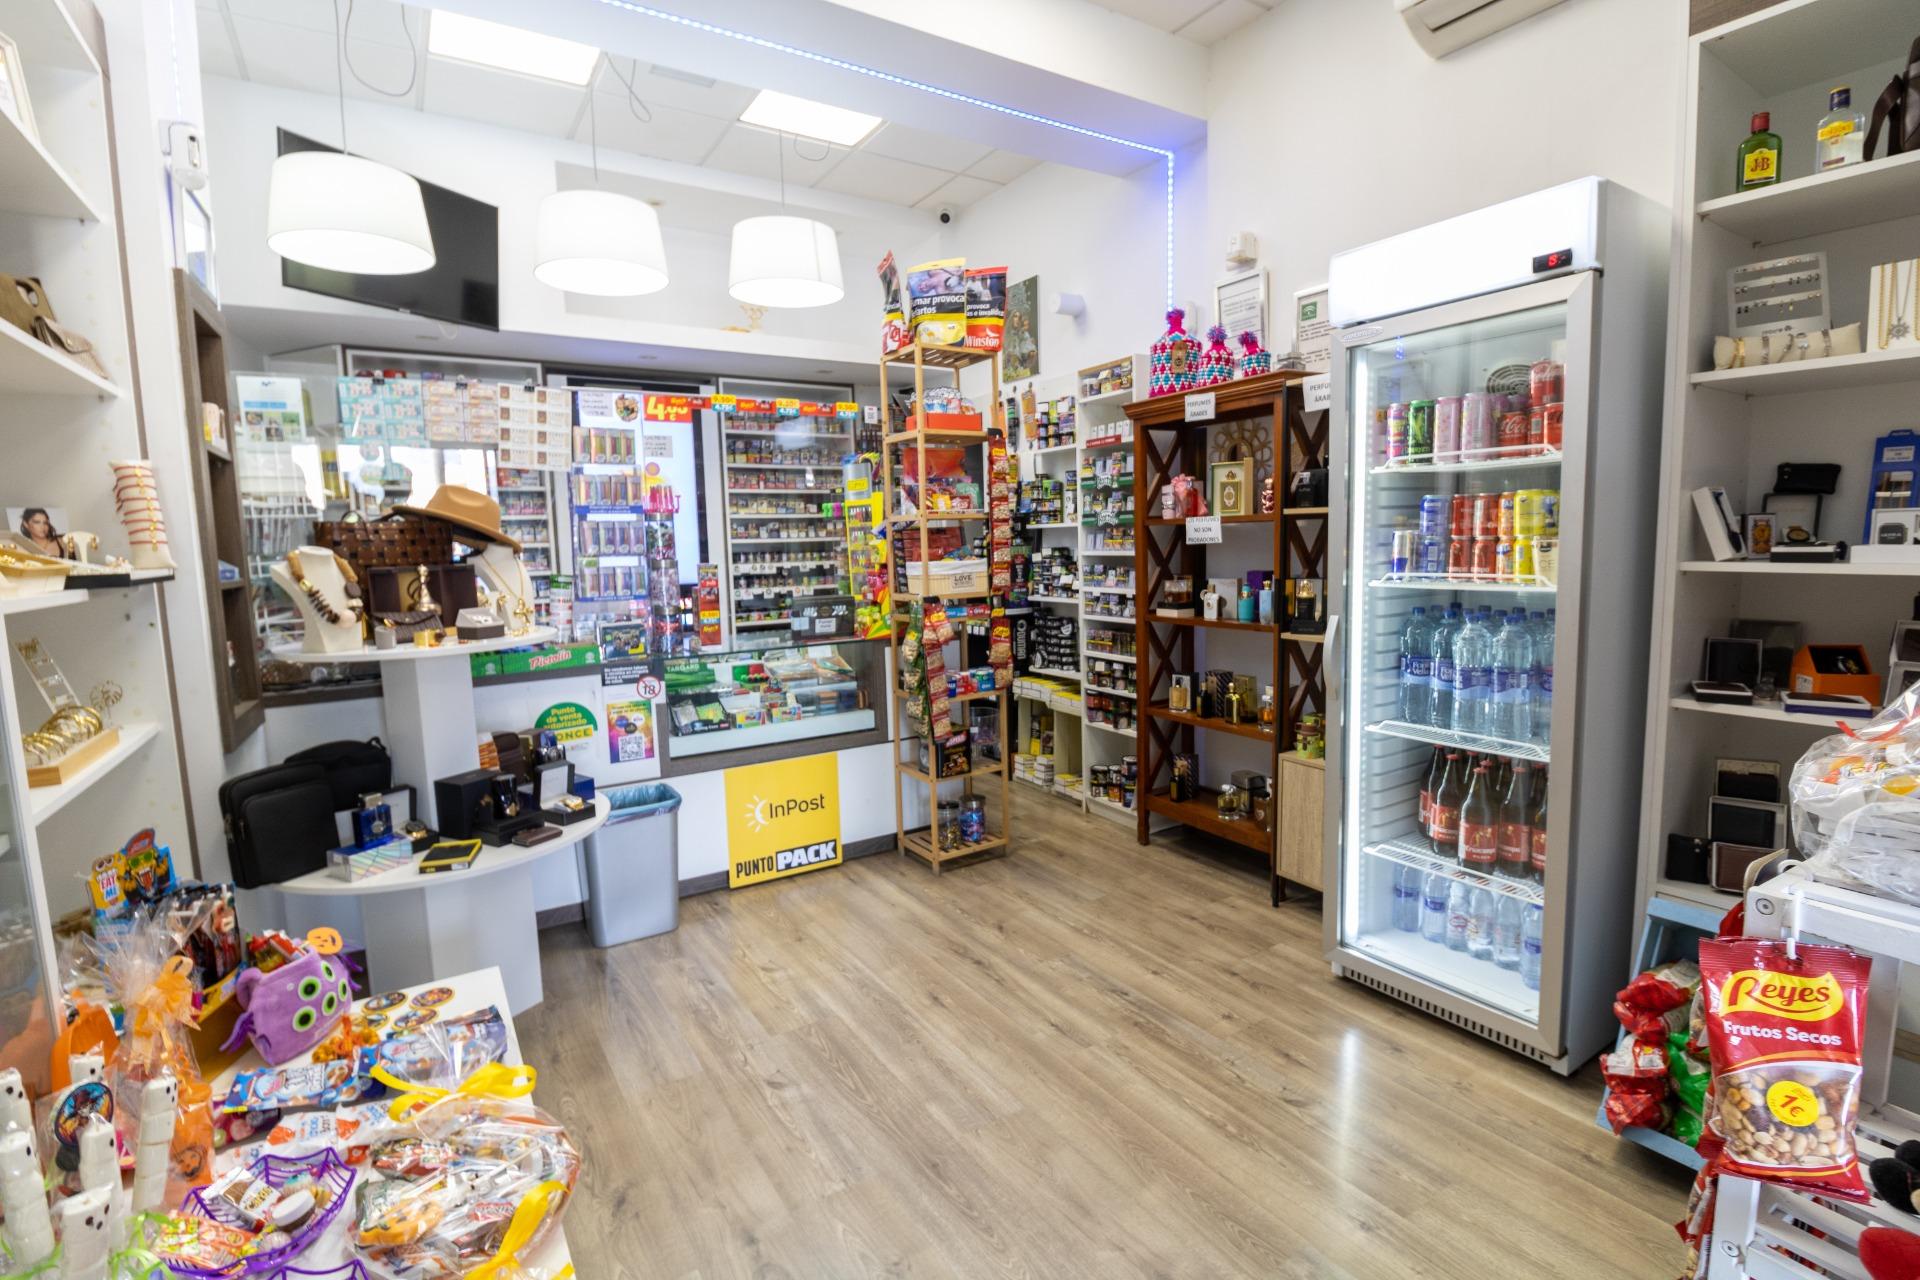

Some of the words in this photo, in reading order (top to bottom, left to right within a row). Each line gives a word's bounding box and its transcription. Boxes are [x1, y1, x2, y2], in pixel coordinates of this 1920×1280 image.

[933, 294, 965, 305] provoca
[964, 335, 1000, 348] Winston
[1309, 383, 1331, 391] PERFU
[641, 683, 656, 695] 18
[551, 706, 576, 716] Punto
[559, 711, 582, 721] venta
[556, 727, 593, 742] ONCE
[769, 793, 825, 818] InPost
[736, 855, 774, 878] PUNTO
[776, 841, 836, 871] PACK
[1728, 976, 1831, 1008] Reyes
[1723, 1020, 1783, 1040] Frutos
[1785, 1026, 1843, 1046] Secos
